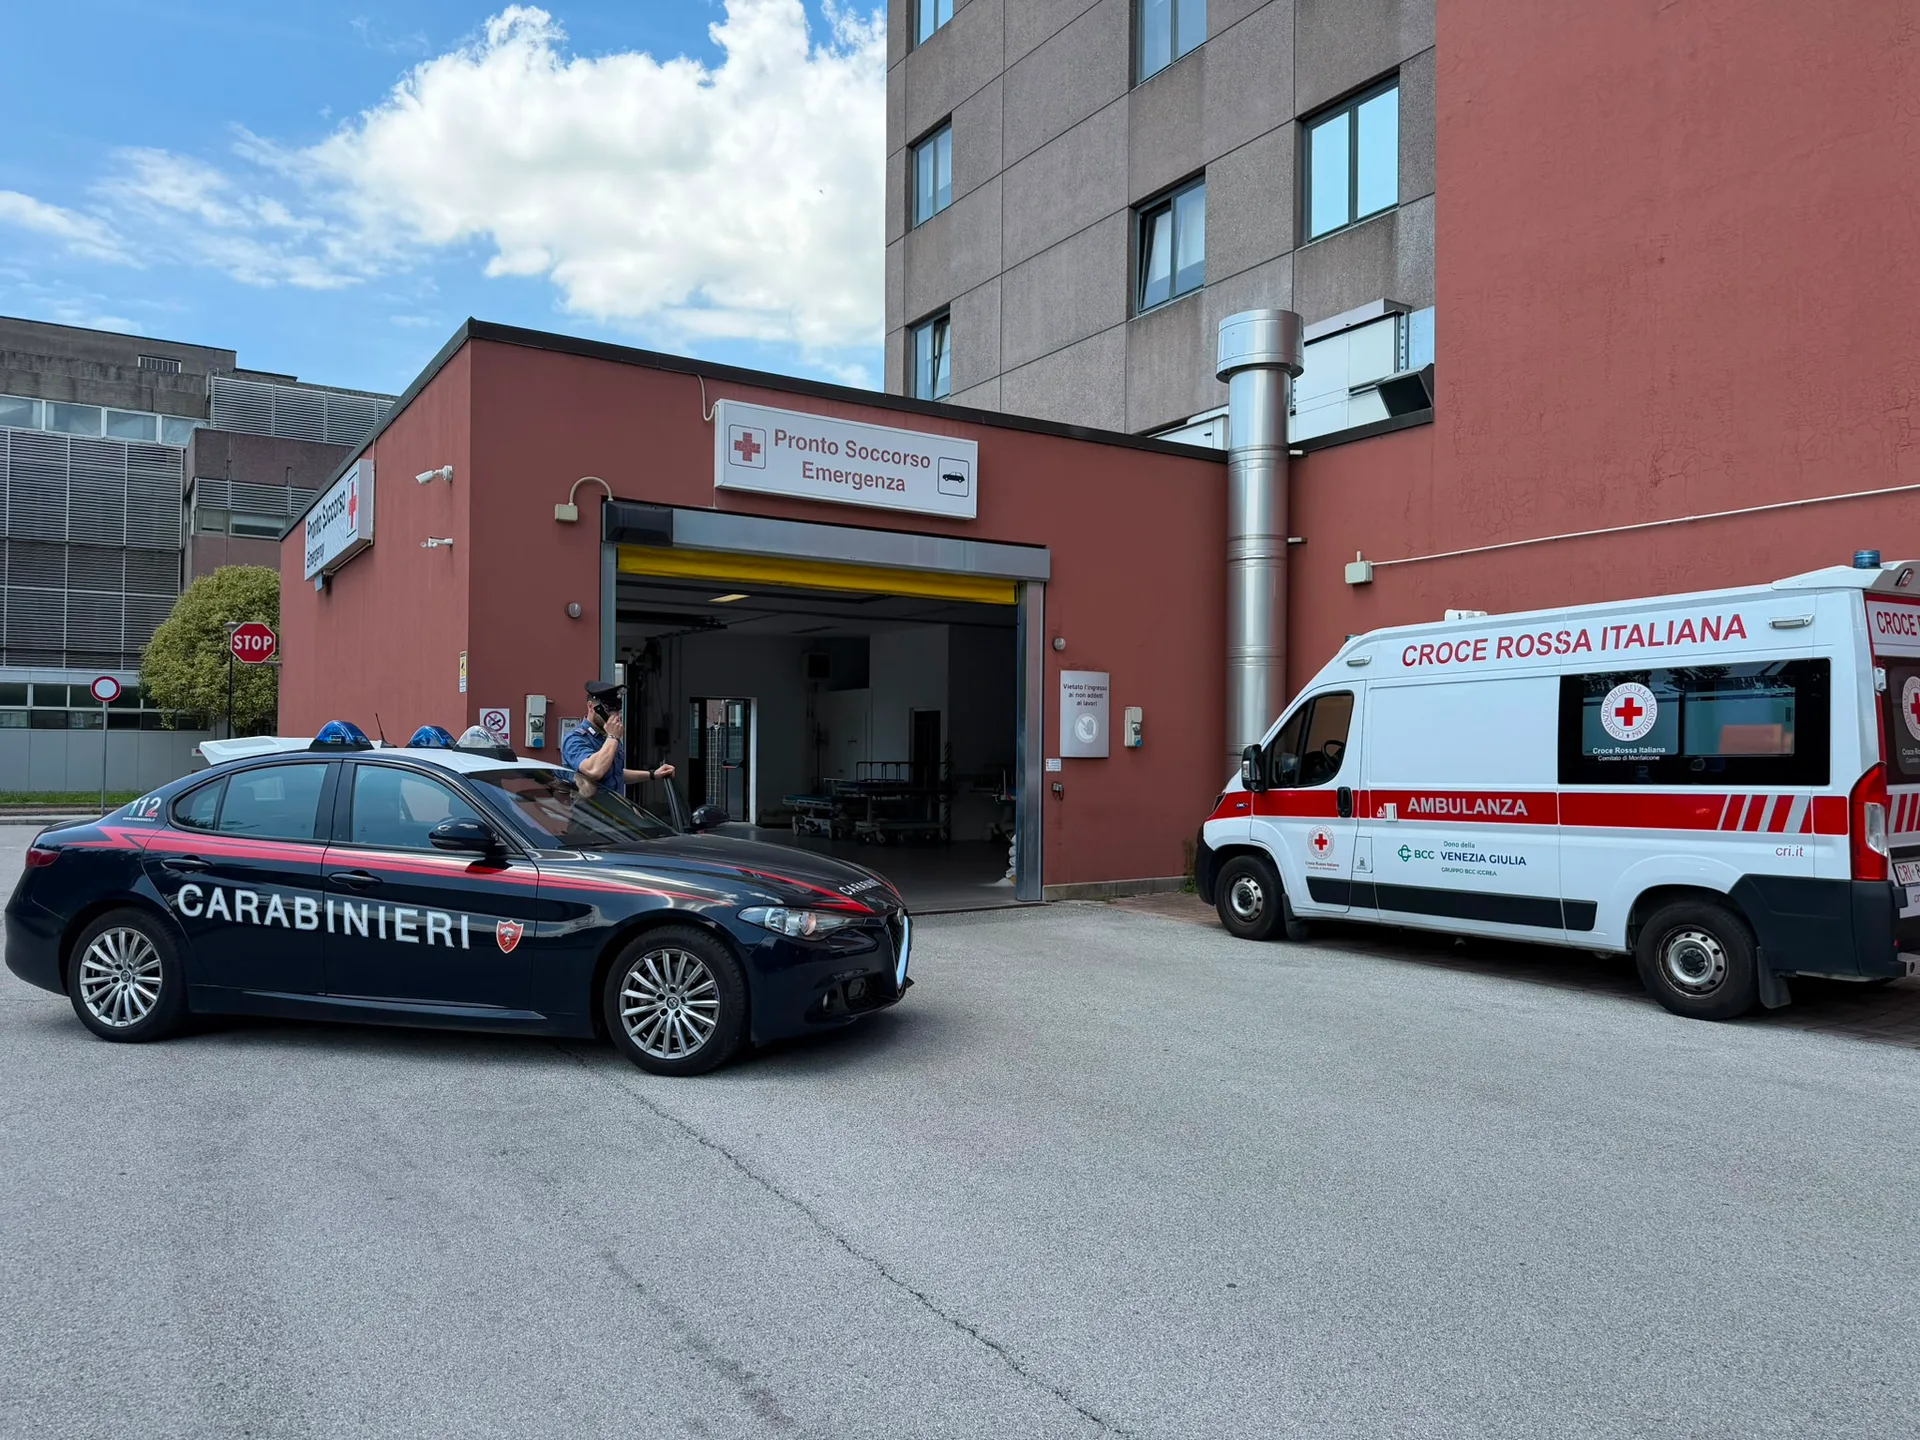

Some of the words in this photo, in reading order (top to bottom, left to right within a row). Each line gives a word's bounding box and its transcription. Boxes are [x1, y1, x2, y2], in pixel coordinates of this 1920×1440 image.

[774, 429, 839, 455] Pronto
[845, 440, 931, 469] Soccorso
[802, 461, 906, 492] Emergenza
[307, 512, 322, 542] Pronto
[322, 490, 346, 529] Soccorso
[1876, 610, 1917, 637] CROCE
[233, 635, 273, 651] STOP
[1401, 638, 1489, 667] CROCE
[1496, 628, 1592, 659] ROSSA
[1601, 613, 1747, 651] ITALIANA
[1084, 684, 1107, 692] l'ingresso
[1614, 746, 1637, 754] Rossa
[128, 796, 162, 818] 112
[1407, 796, 1529, 817] AMBULANZA
[1443, 840, 1460, 848] Dono
[1460, 841, 1476, 849] della
[1775, 845, 1804, 857] cri.it
[1414, 849, 1435, 860] BCC
[1440, 851, 1487, 863] VENEZIA
[1488, 854, 1527, 866] GIULIA
[1441, 866, 1464, 874] GRUPPO
[1897, 864, 1913, 882] CRI
[176, 883, 470, 950] CARABINIERI
